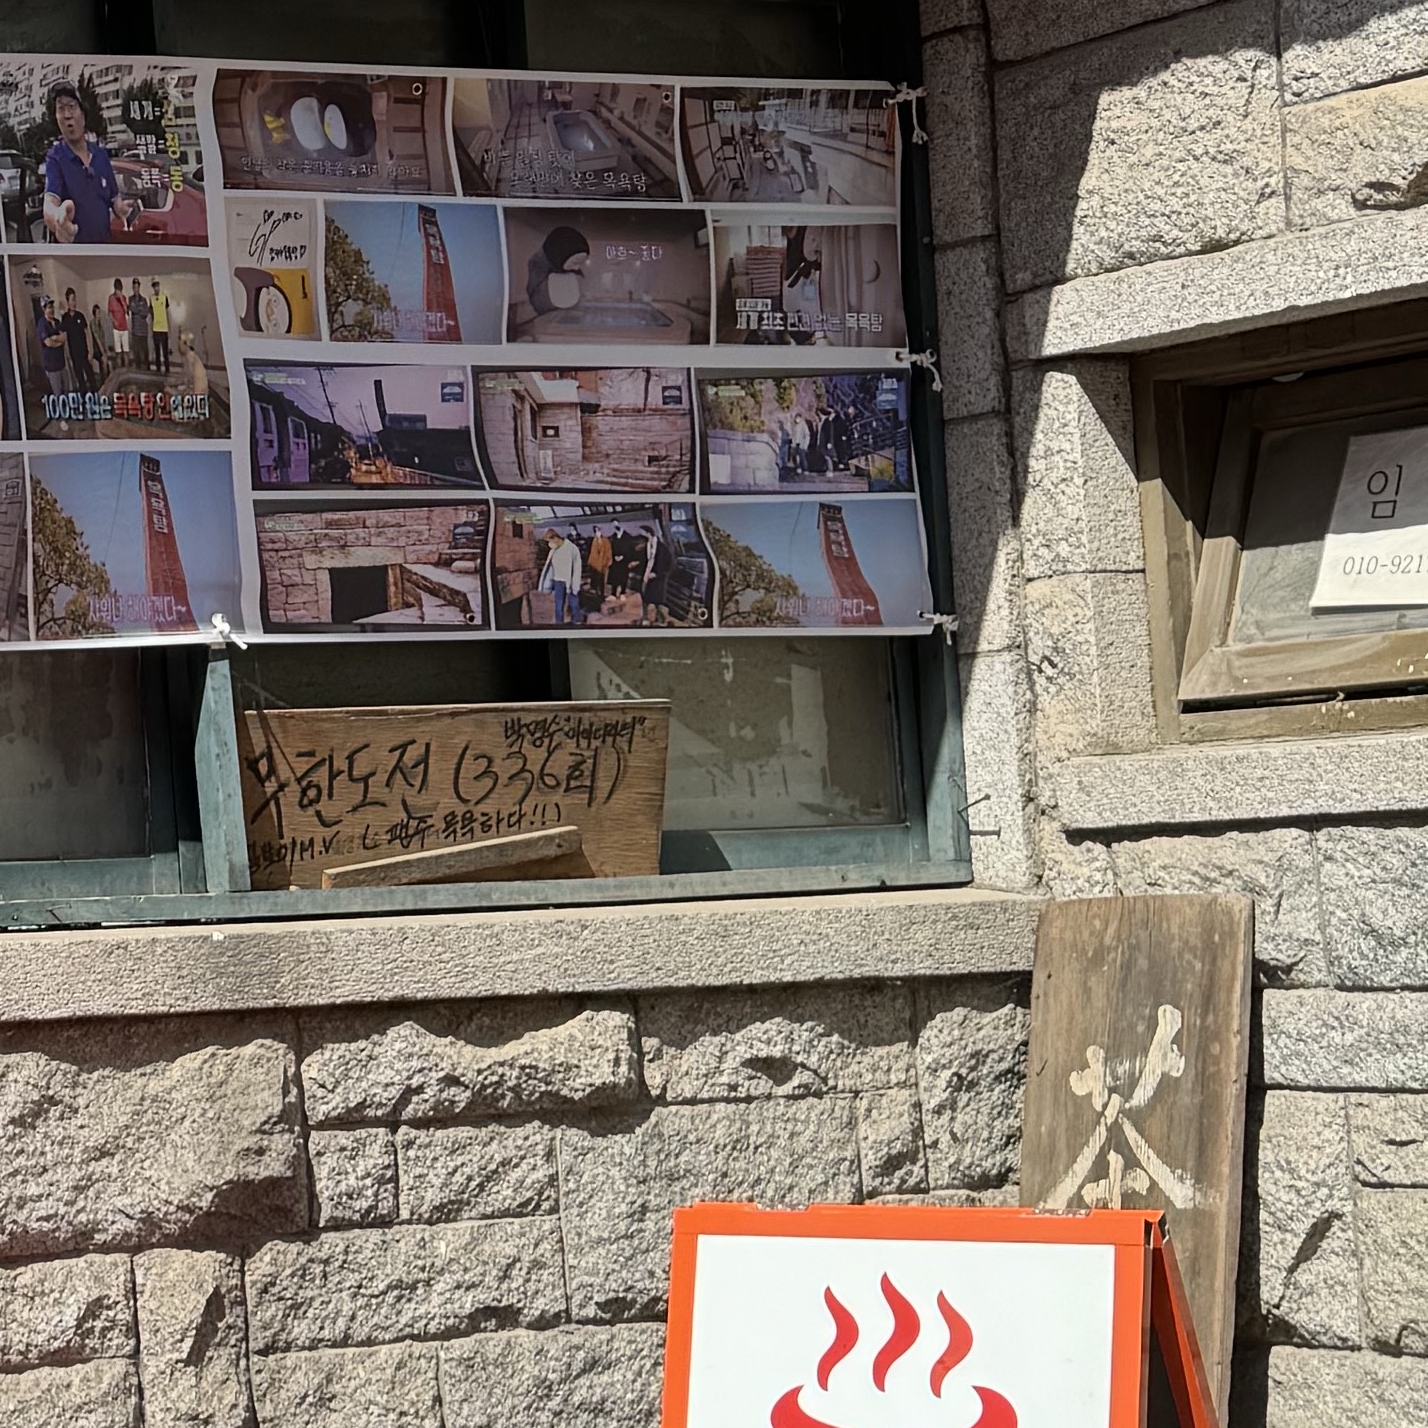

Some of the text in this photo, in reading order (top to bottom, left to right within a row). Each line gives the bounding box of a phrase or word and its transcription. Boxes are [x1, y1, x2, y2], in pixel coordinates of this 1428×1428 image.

[601, 171, 648, 193] 목욕탕
[845, 312, 883, 333] 목욕탕
[1367, 465, 1403, 519] 임
[245, 738, 438, 840] 무한도전
